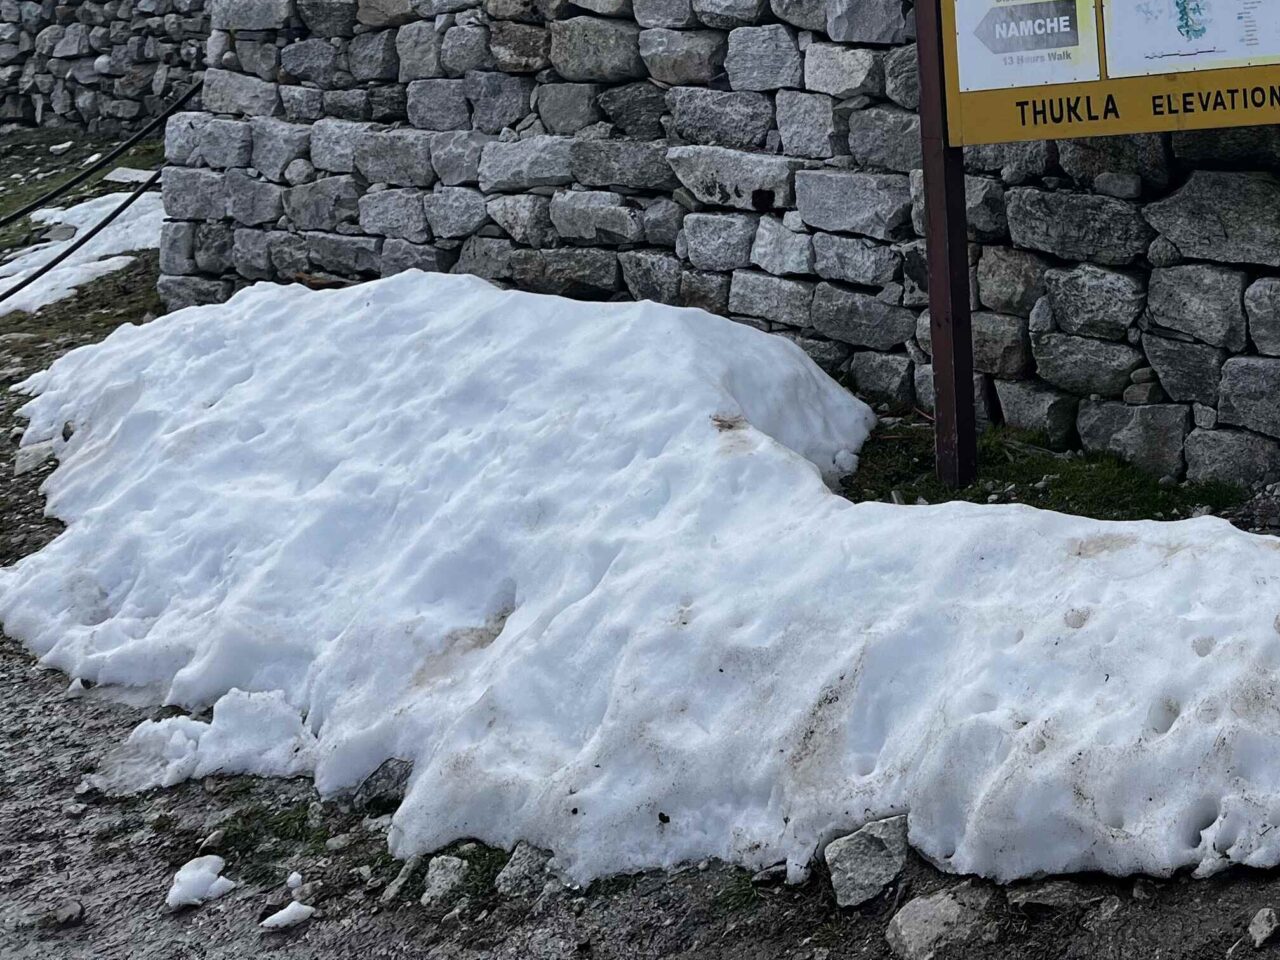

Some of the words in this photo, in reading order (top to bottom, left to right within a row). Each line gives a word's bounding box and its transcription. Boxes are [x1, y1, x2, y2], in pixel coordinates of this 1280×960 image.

[995, 16, 1071, 39] NAMCHE
[1047, 51, 1072, 62] Walk
[1016, 94, 1120, 127] THUKLA
